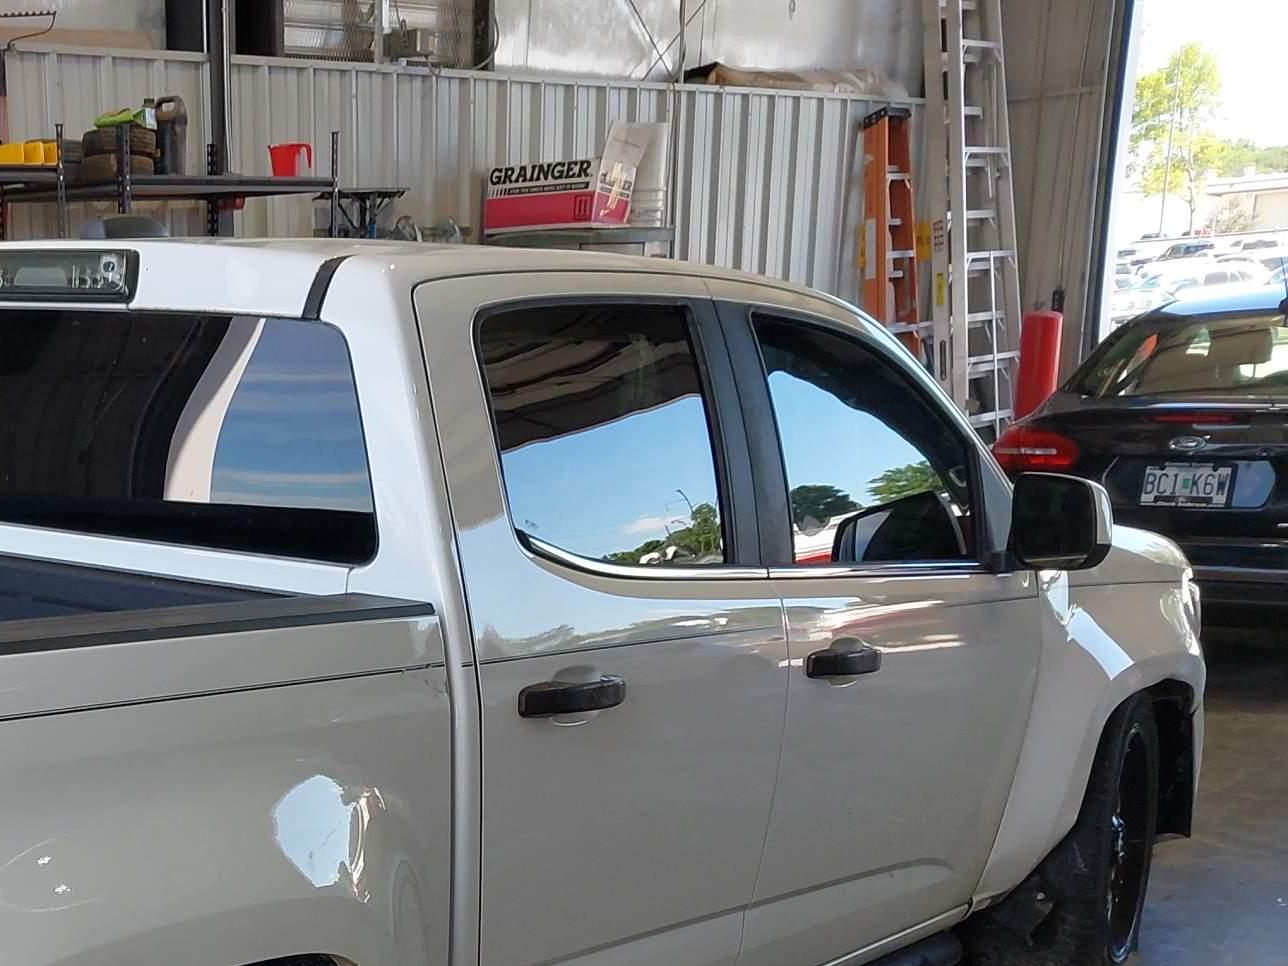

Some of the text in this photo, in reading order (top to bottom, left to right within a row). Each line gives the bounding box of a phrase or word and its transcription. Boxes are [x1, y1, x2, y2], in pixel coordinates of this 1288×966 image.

[489, 160, 592, 186] GRAINGER
[1143, 472, 1230, 496] BC1 K6W
